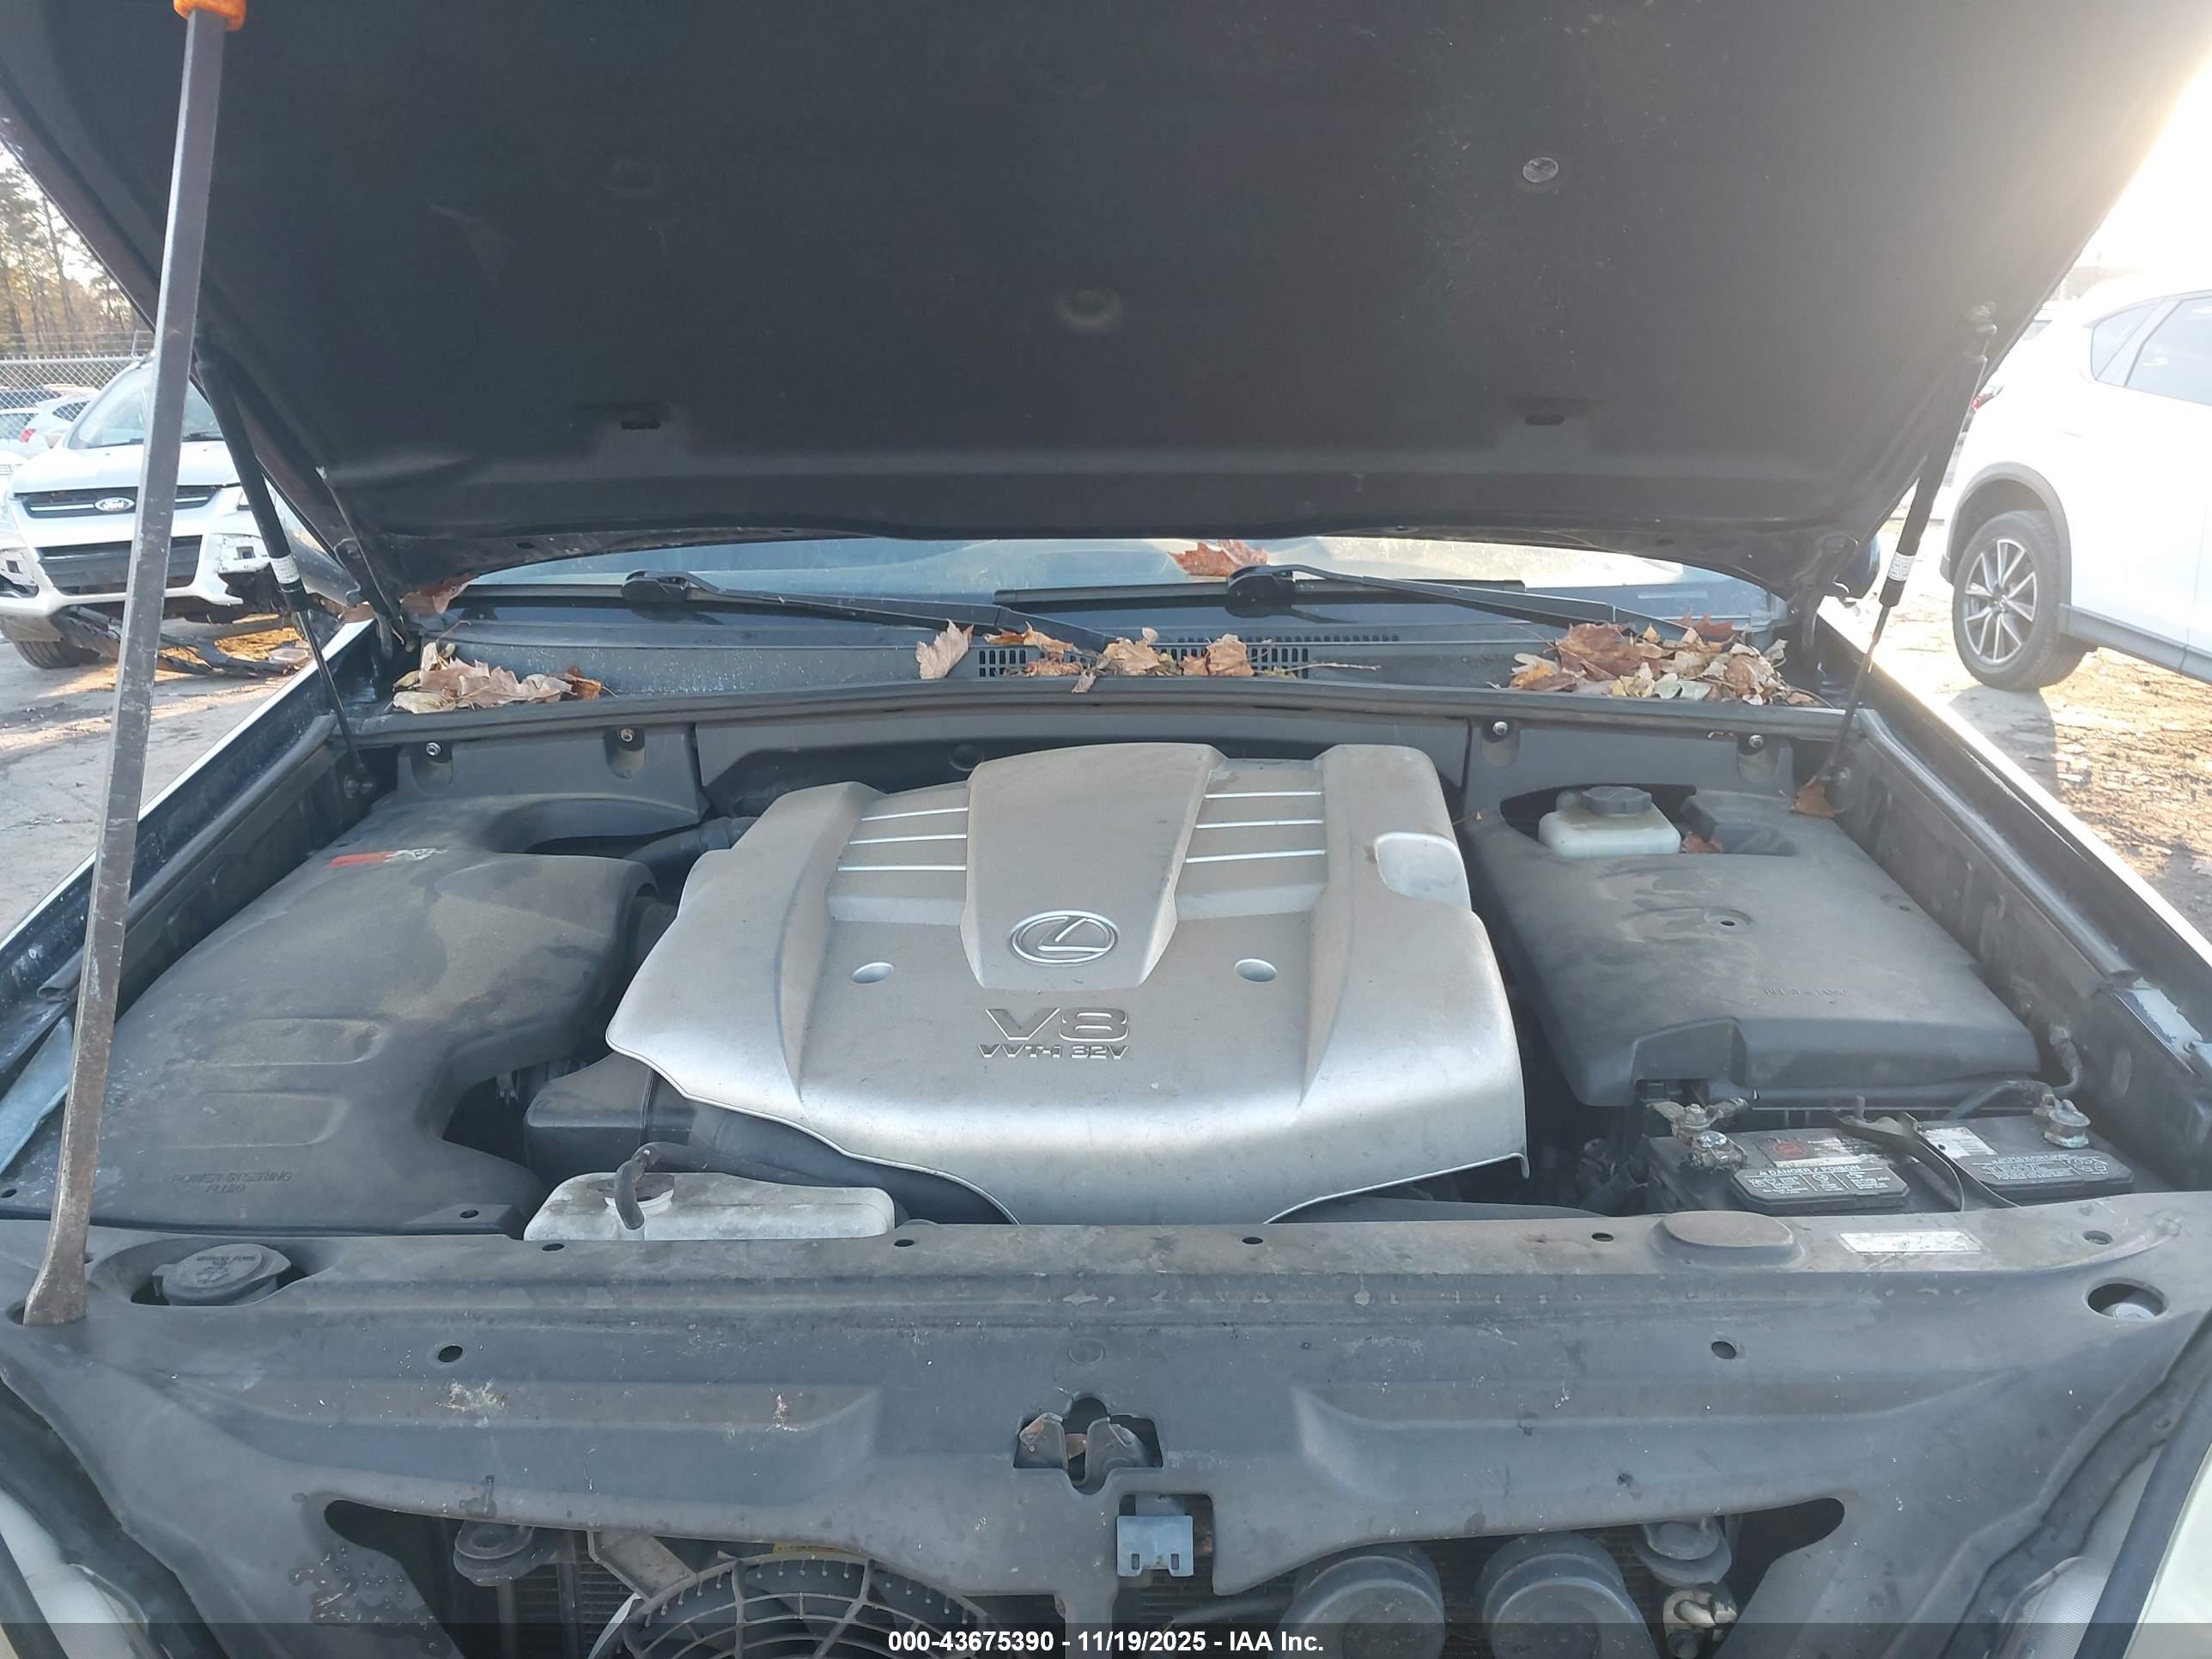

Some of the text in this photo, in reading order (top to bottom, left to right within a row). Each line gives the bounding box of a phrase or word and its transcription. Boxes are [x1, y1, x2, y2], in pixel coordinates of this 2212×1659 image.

[985, 1007, 1128, 1042] V8
[1071, 1044, 1128, 1059] 32V
[171, 1170, 294, 1183] POWER STEERING
[1768, 1167, 1812, 1176] DANGER
[1821, 1164, 1862, 1174] POISON
[205, 1183, 246, 1194] FLUID
